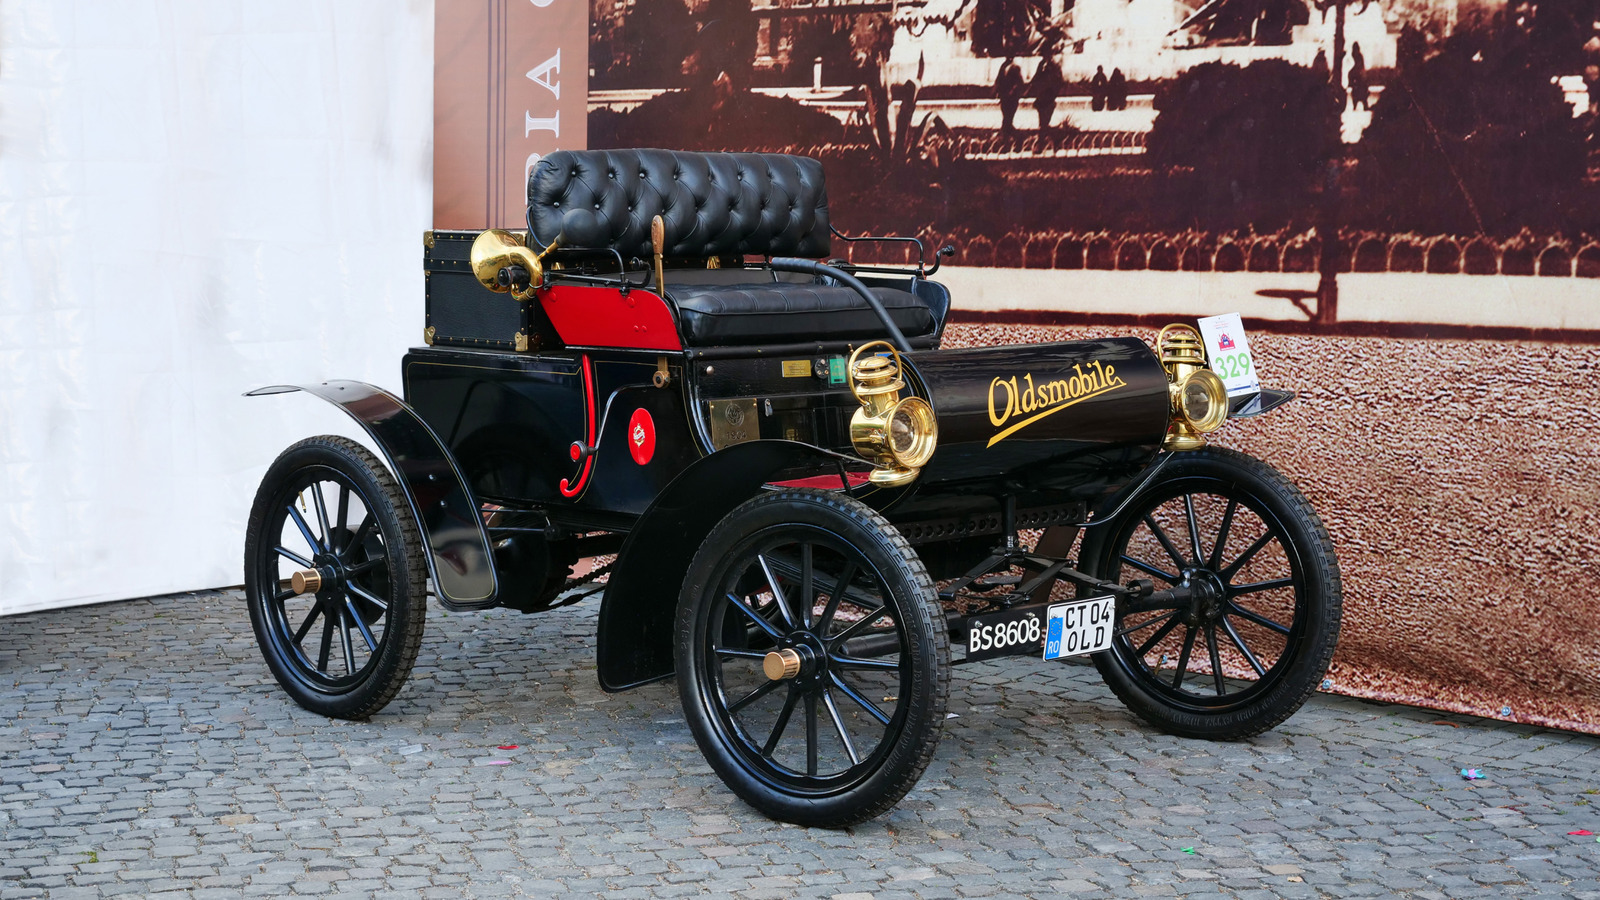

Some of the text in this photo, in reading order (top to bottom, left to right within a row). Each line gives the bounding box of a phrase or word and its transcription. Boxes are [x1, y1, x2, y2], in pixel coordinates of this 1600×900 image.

[1215, 352, 1250, 380] 329
[988, 359, 1127, 427] Oldsmobile
[1065, 601, 1110, 629] CT 04
[969, 617, 1041, 653] BS8608
[1047, 640, 1060, 655] RO
[1067, 626, 1105, 653] OLD
